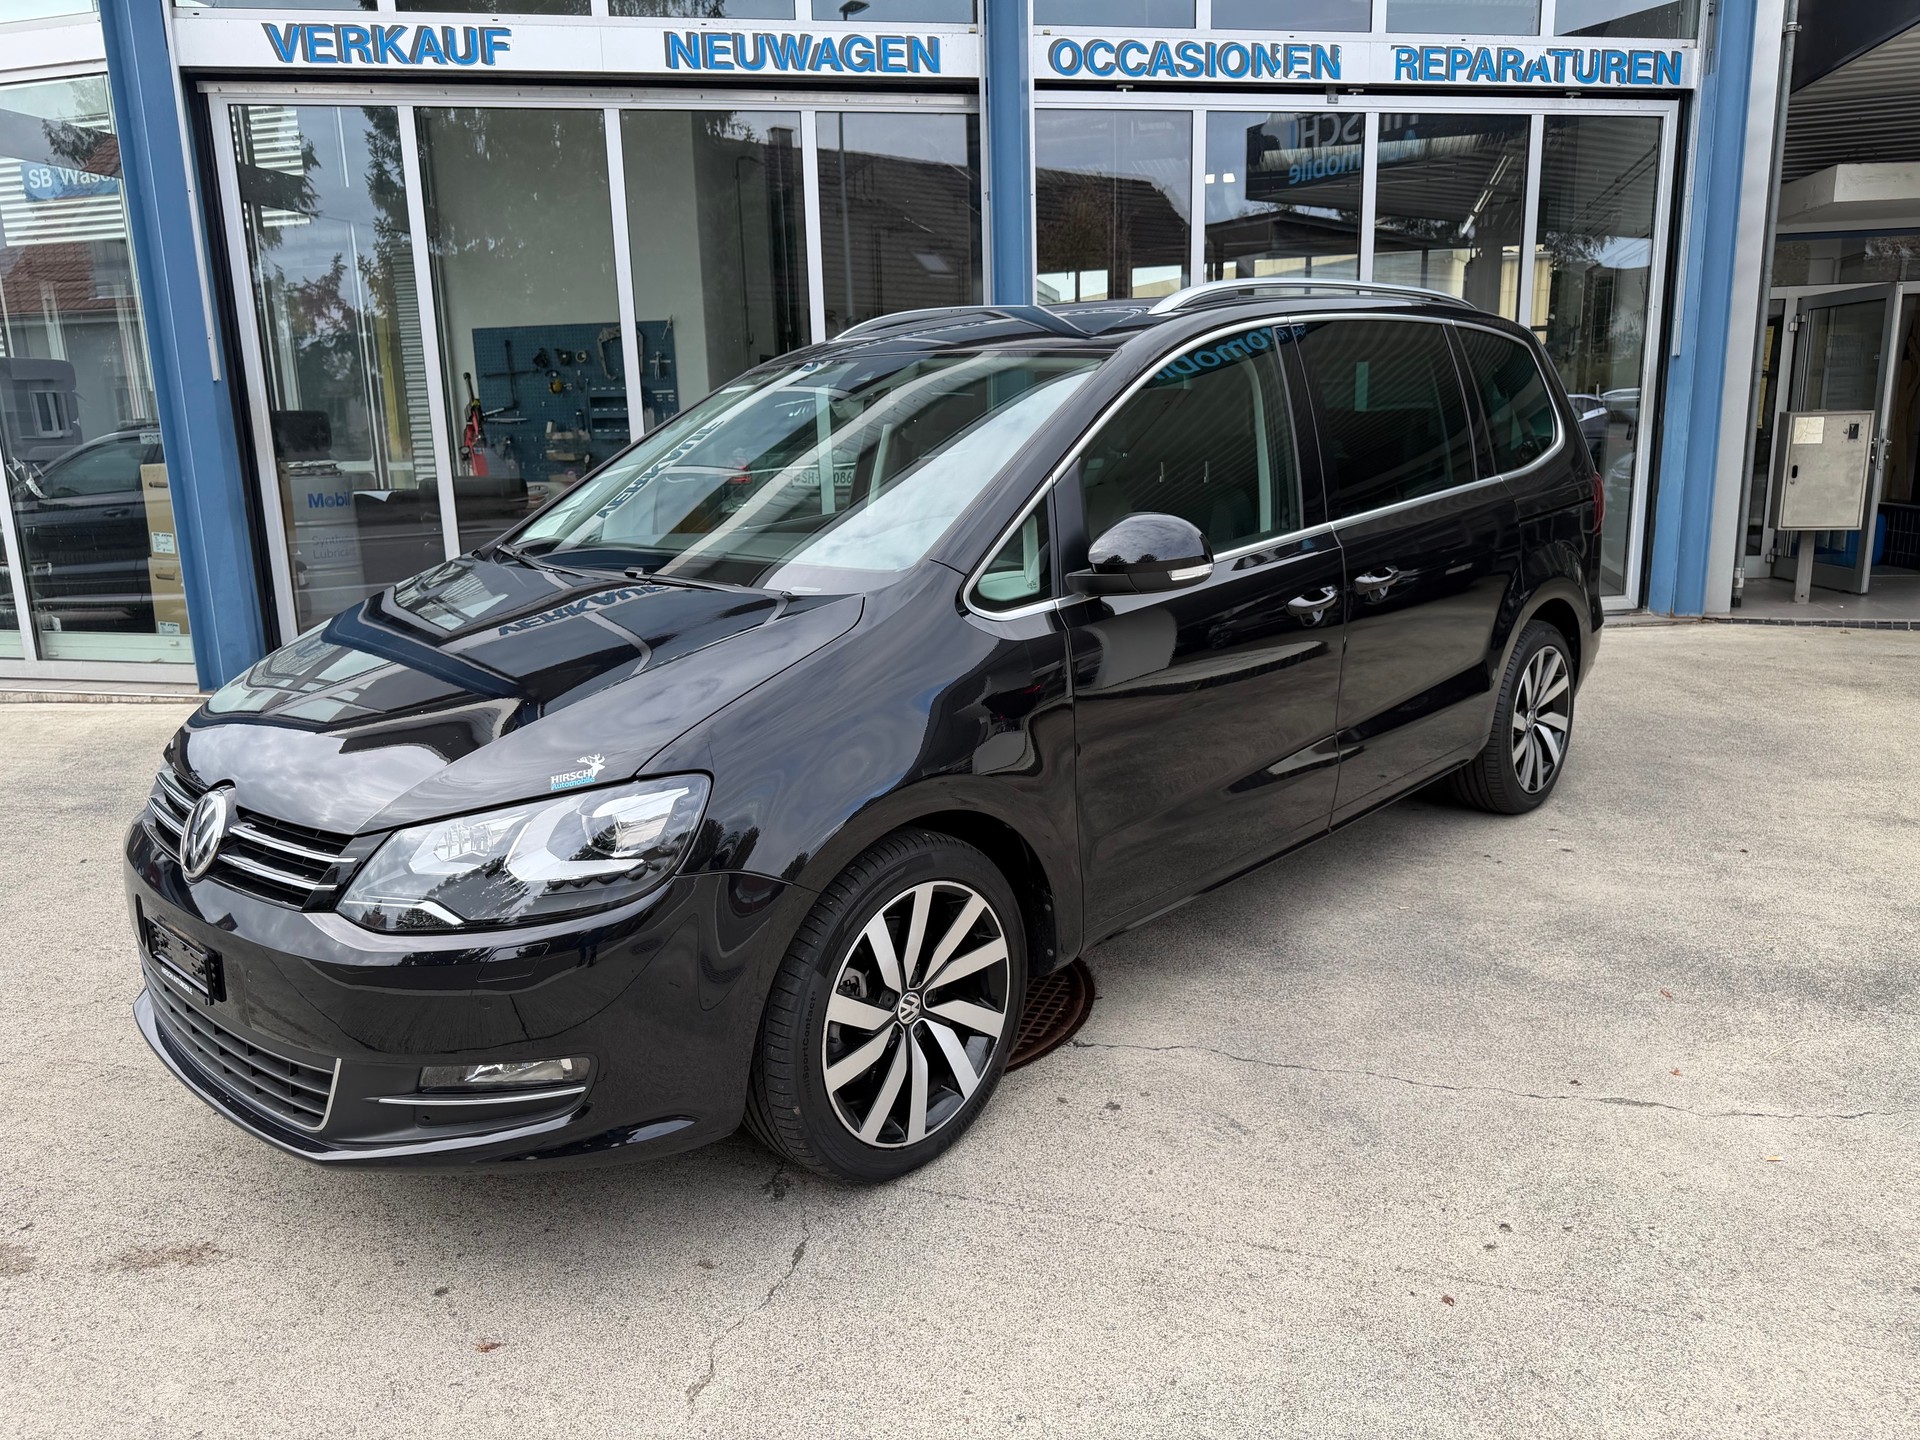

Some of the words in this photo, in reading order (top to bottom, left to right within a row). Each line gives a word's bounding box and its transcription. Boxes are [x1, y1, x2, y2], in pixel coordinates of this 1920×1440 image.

[261, 23, 511, 66] VERKAUF
[664, 31, 941, 74] NEUWAGEN
[1048, 38, 1342, 80] OCCASIONEN
[1391, 45, 1683, 86] REPARATUREN
[28, 167, 52, 189] SB
[57, 166, 117, 186] Wasc
[307, 490, 351, 509] Mobil
[550, 768, 593, 784] HIRSCH
[551, 775, 596, 791] Automobile
